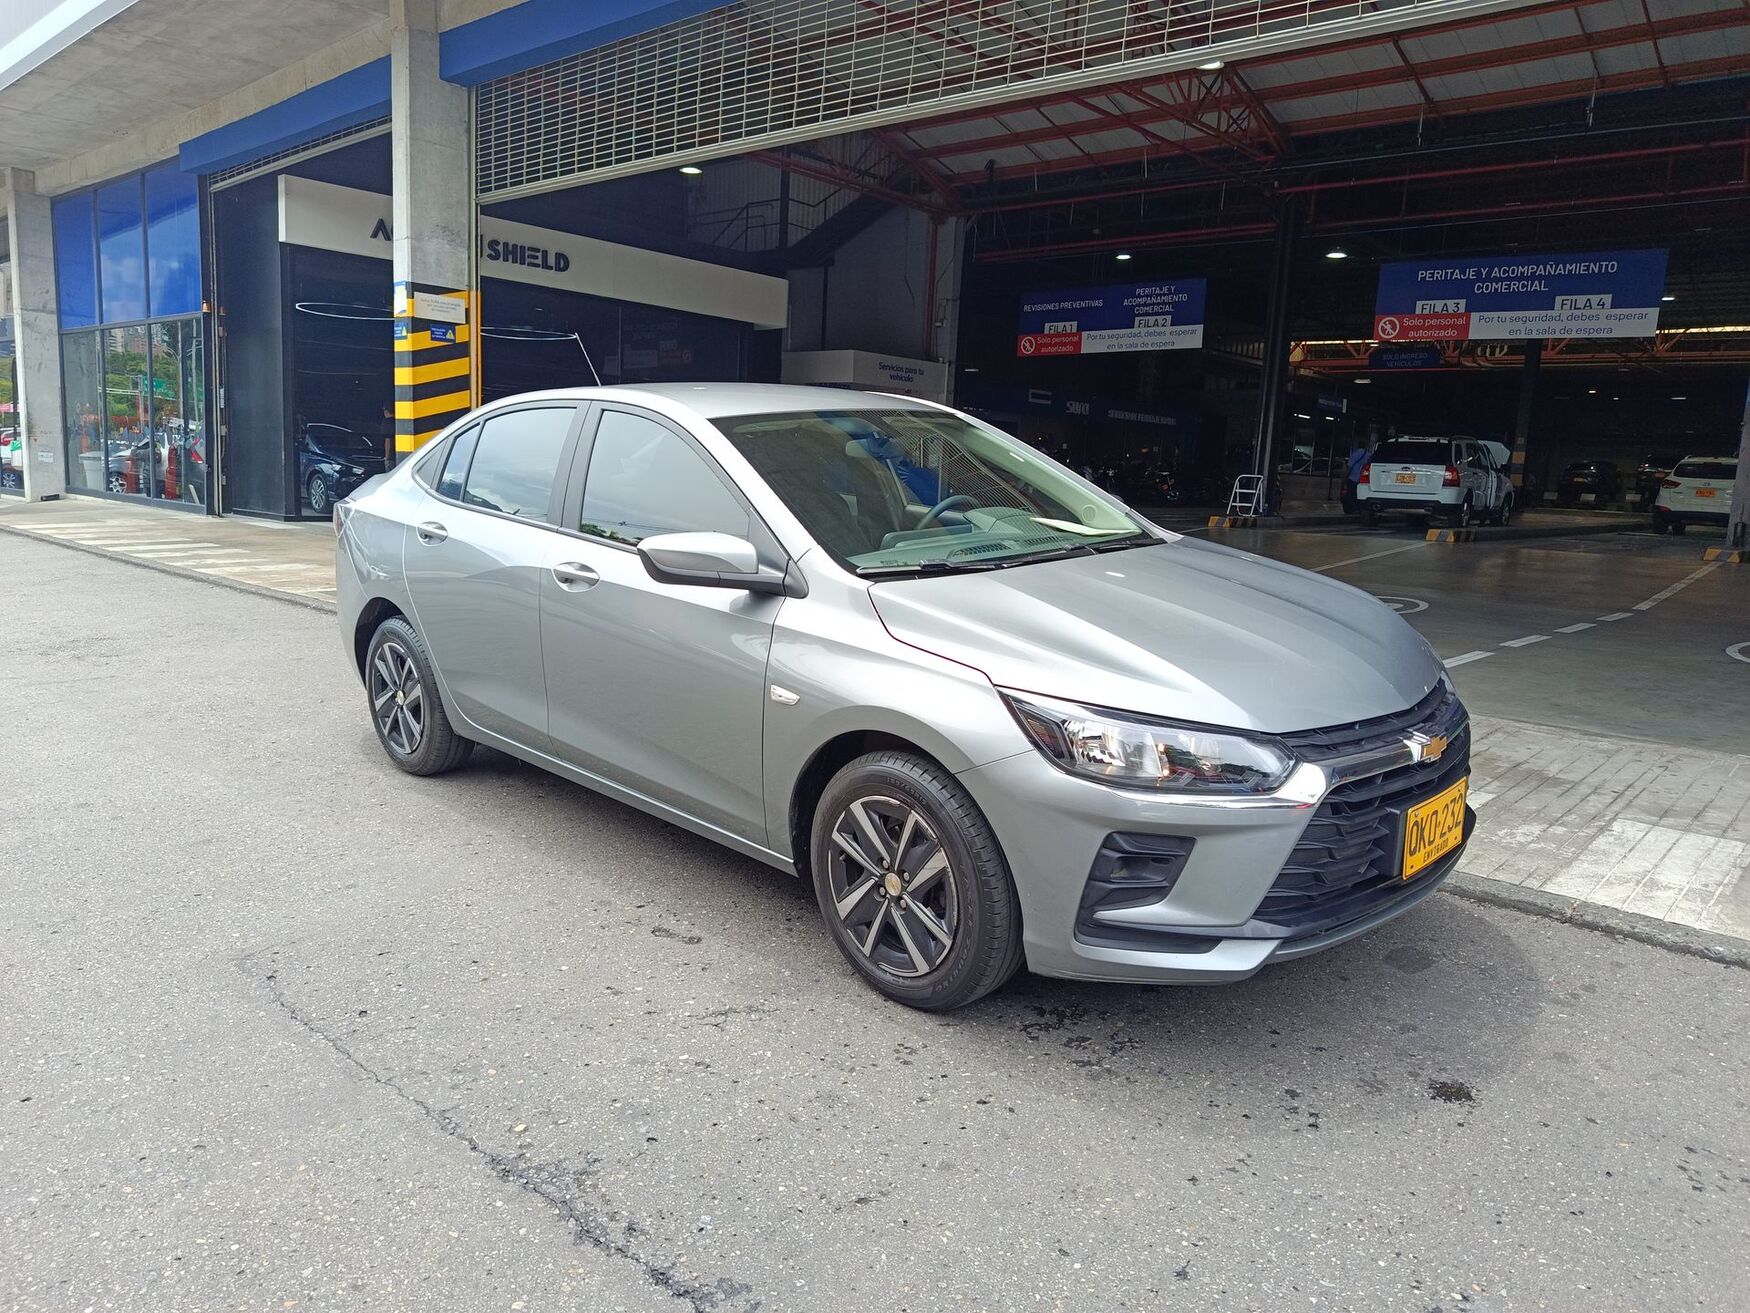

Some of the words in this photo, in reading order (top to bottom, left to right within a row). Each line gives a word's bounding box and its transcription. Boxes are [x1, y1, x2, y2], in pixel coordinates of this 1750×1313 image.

[486, 239, 570, 273] SHIELD
[1417, 267, 1478, 281] PERITAJE
[1480, 266, 1490, 278] Y
[1491, 261, 1618, 278] ACOMPAÑAMIENTO
[1136, 286, 1170, 296] PERITAJE
[1170, 285, 1176, 293] Y
[1474, 280, 1549, 294] COMERCIAL
[1023, 303, 1059, 312] REVISIONES
[1060, 299, 1104, 310] PREVENTIVAS
[1123, 293, 1188, 306] ACOMPAÑAMIENTO
[1560, 298, 1593, 311] FILA
[1596, 297, 1606, 310] 4
[1134, 305, 1175, 314] COMERCIAL
[1420, 303, 1451, 314] FILA
[1452, 302, 1460, 314] 3
[1138, 318, 1160, 329] FILA
[1160, 317, 1168, 328] 2
[1403, 317, 1424, 326] Solo
[1425, 316, 1466, 328] personal
[1478, 315, 1495, 324] Por
[1497, 315, 1508, 324] tu
[1509, 313, 1564, 326] seguridad,
[1566, 312, 1600, 322] debes
[1605, 311, 1649, 323] esperar
[1048, 324, 1067, 334] FILA
[1068, 324, 1073, 333] 1
[1087, 333, 1098, 341] Por
[1106, 330, 1143, 341] seguridad,
[1144, 329, 1167, 338] debes
[1170, 329, 1198, 338] esperar
[1408, 328, 1458, 338] autorizado
[1508, 328, 1521, 336] en
[1523, 326, 1534, 336] la
[1534, 326, 1557, 336] sala
[1559, 325, 1575, 335] de
[1576, 325, 1613, 338] espera
[1037, 336, 1051, 344] Solo
[1050, 335, 1079, 345] personal
[1117, 341, 1124, 349] la
[1124, 341, 1139, 349] sala
[1140, 341, 1150, 349] de
[1150, 340, 1175, 350] espera
[1041, 345, 1074, 353] autorizado
[878, 361, 904, 374] Servicios
[904, 366, 918, 376] para
[1423, 838, 1449, 862] ENVIGADO
